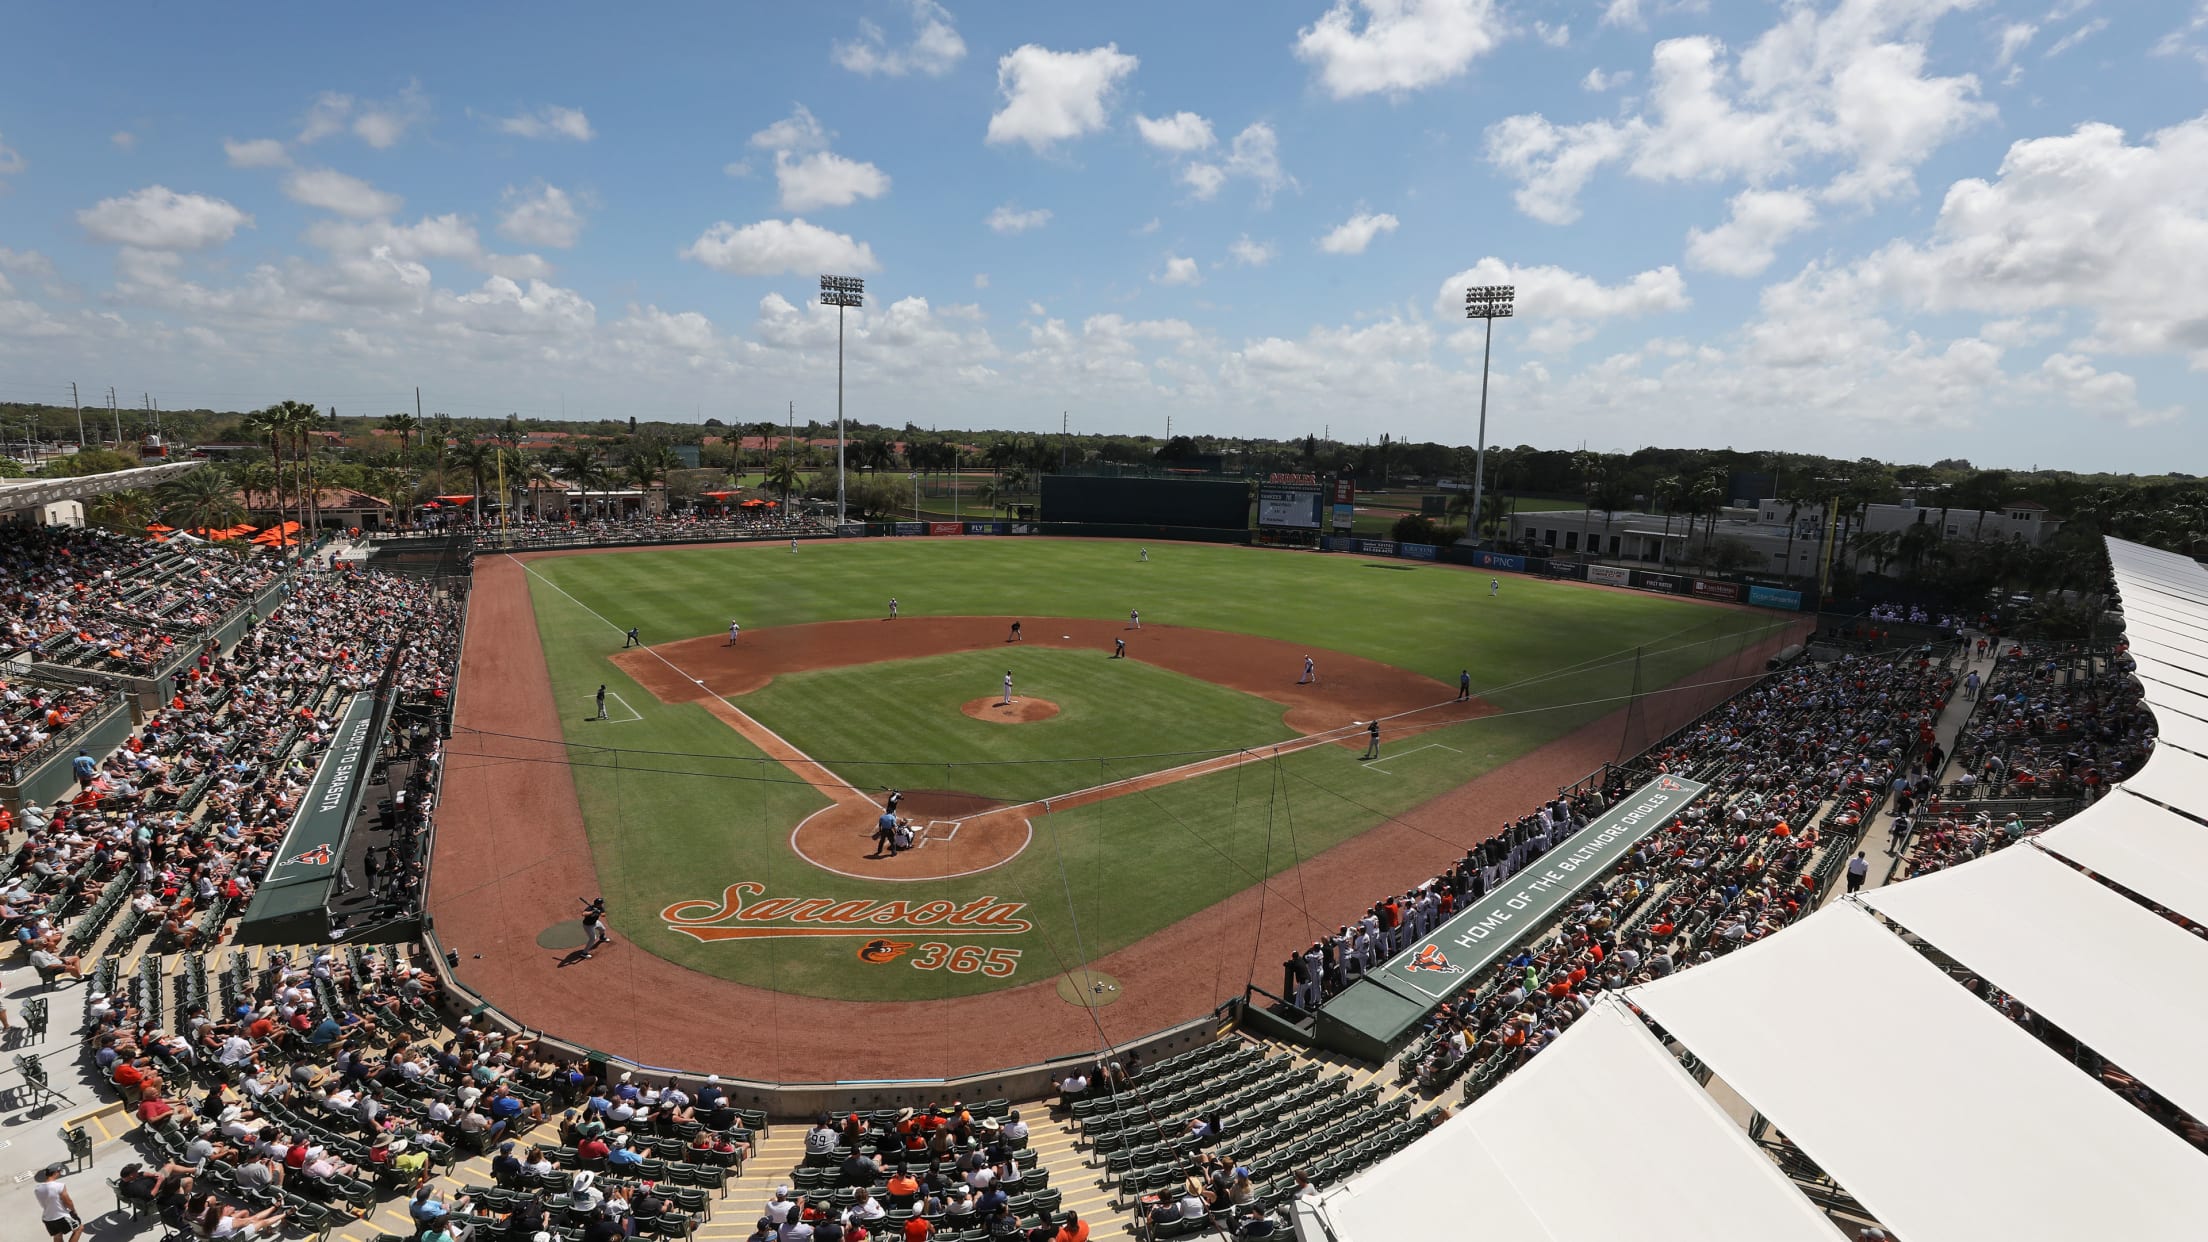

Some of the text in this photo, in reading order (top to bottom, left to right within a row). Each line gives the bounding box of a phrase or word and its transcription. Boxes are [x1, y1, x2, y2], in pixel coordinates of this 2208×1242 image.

[1493, 557, 1514, 569] PNC
[340, 752, 358, 764] TO
[319, 764, 353, 813] SARASOTA
[1454, 792, 1670, 949] HOME OF THE BALTIMORE ORIOLES
[660, 881, 1033, 938] Sarasota
[911, 942, 1024, 979] 365
[811, 1135, 825, 1146] 99
